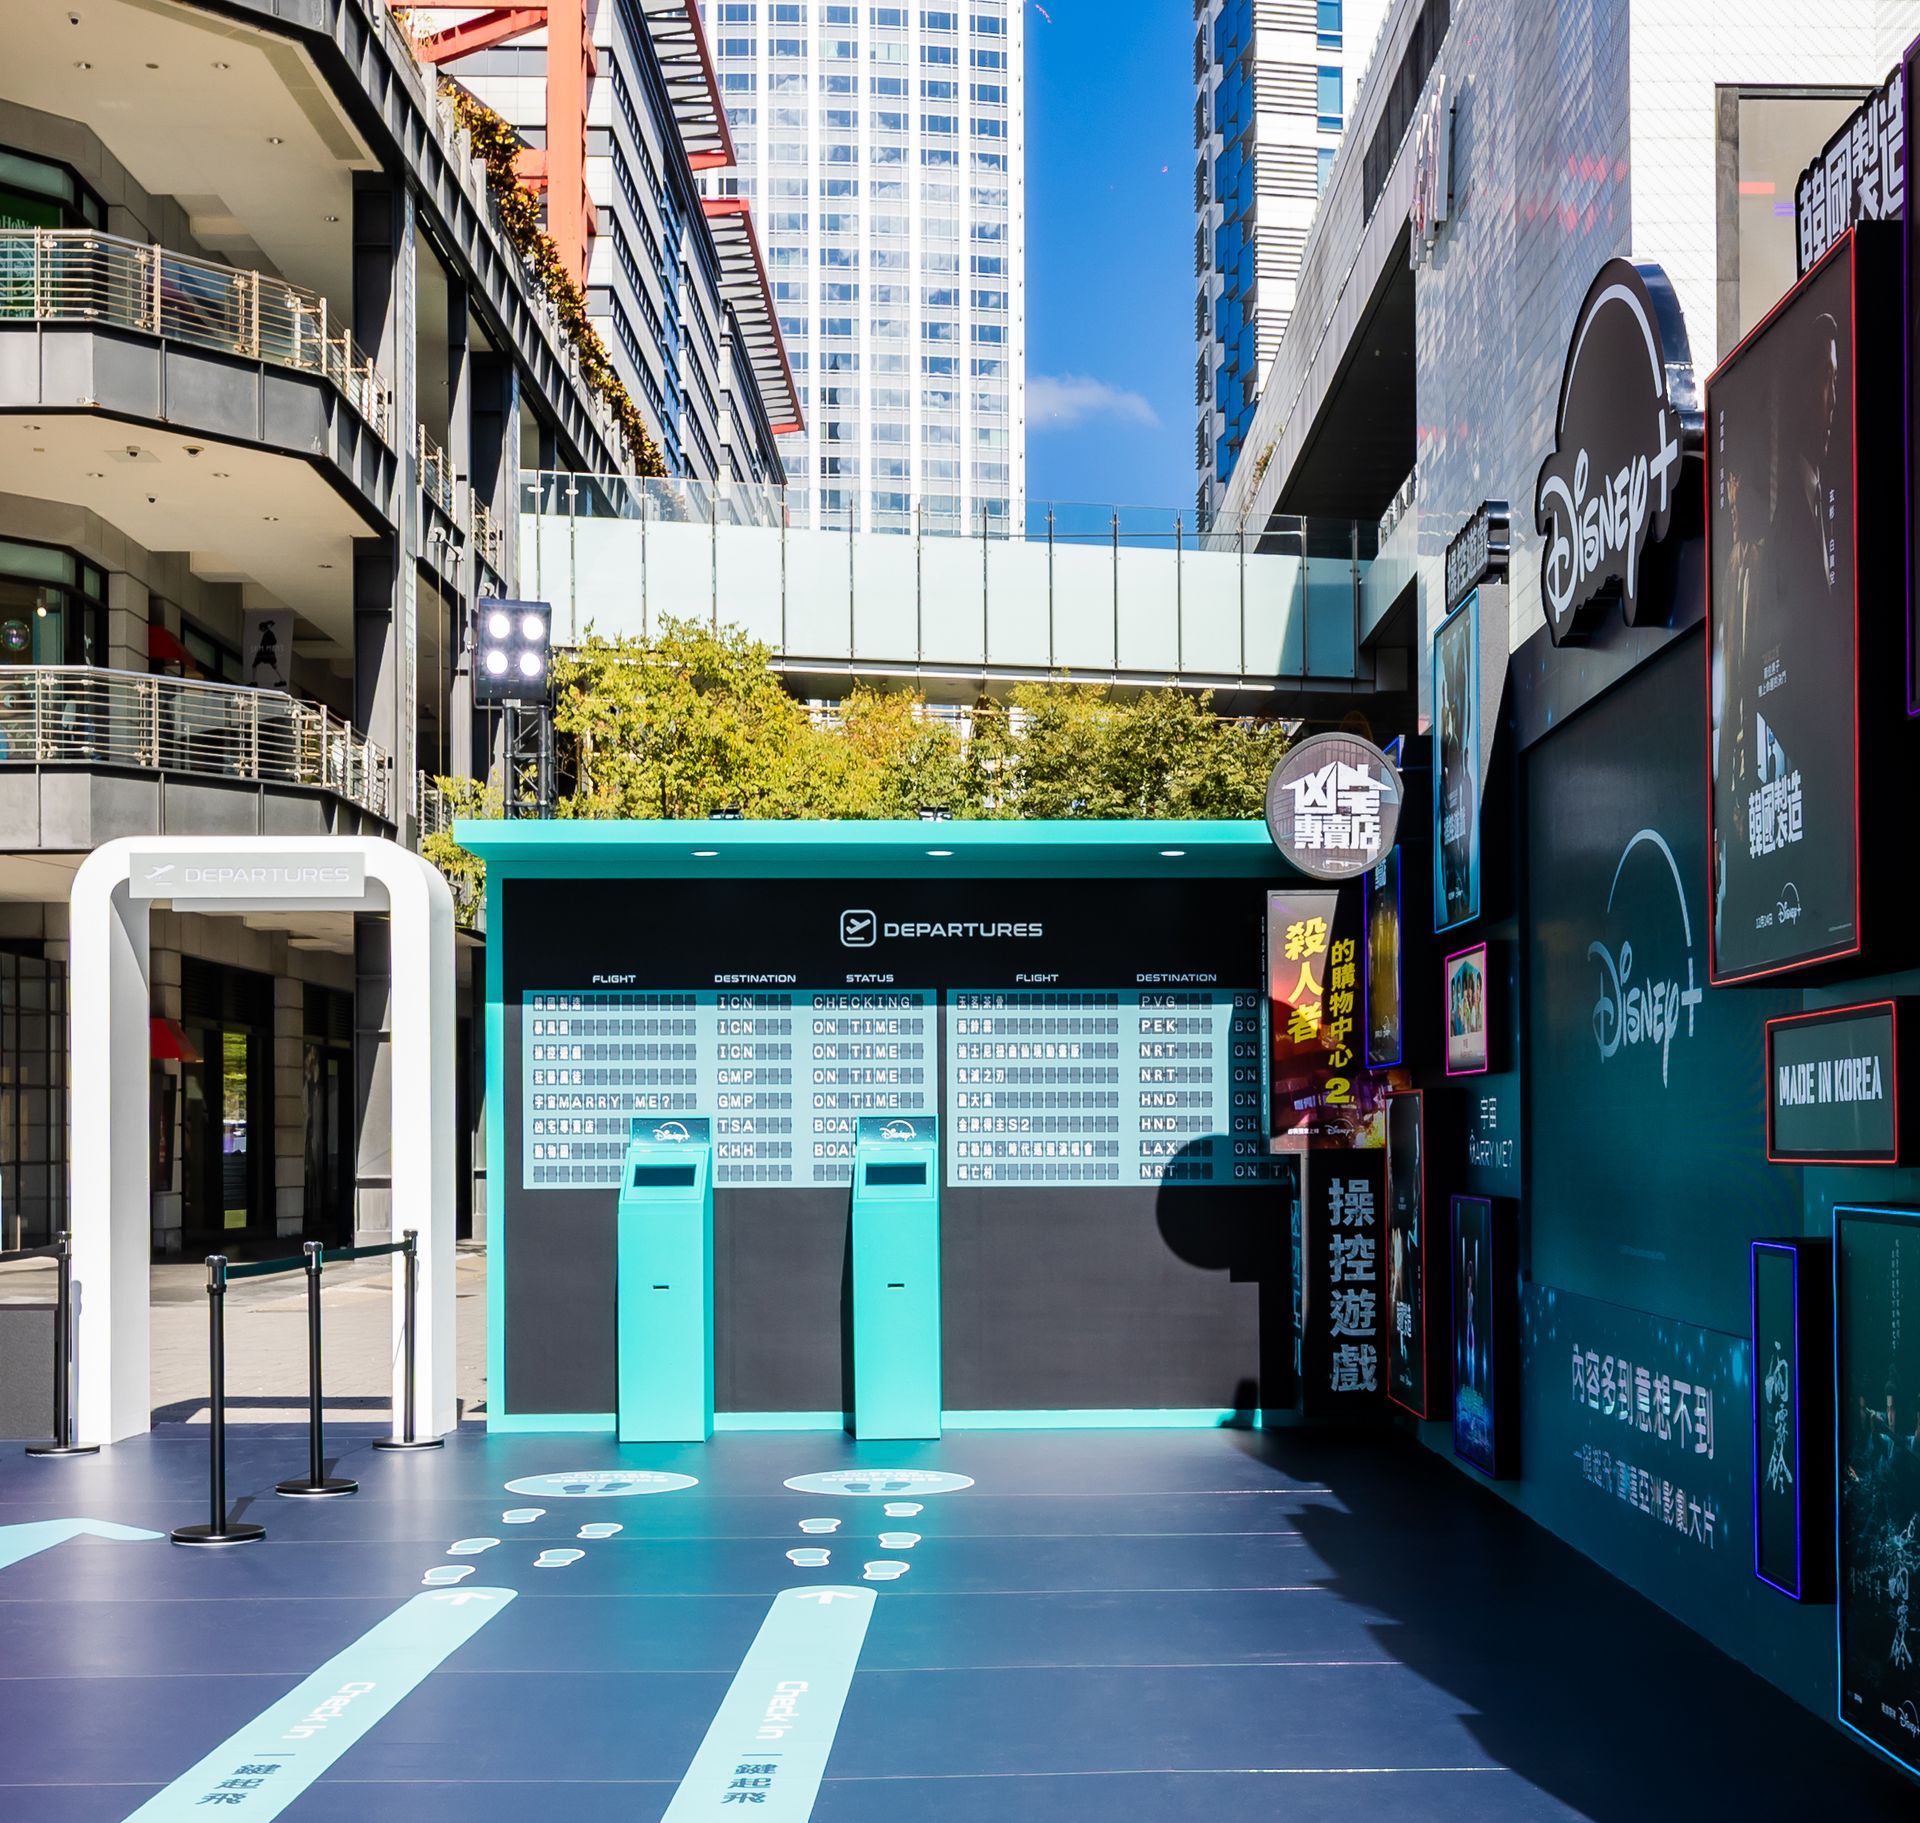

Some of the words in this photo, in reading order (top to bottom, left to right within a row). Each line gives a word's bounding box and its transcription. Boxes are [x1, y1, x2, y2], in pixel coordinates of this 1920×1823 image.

[1748, 769, 1804, 859] 韓國製造
[1294, 815, 1382, 850] 專賣店
[184, 866, 350, 884] DEPARTURES
[884, 922, 1043, 938] DEPARTURES
[592, 974, 637, 984] FLIGHT
[714, 974, 797, 983] DESTINATION
[846, 974, 895, 983] STATUS
[1015, 973, 1059, 983] FLIGHT
[1136, 974, 1217, 983] DESTINATION
[1284, 916, 1328, 1044] 殺人者
[719, 997, 753, 1009] ICN
[814, 996, 911, 1009] CHECKING
[1142, 996, 1175, 1008] PVG
[1588, 941, 1703, 1089] Disney+
[719, 1021, 753, 1033] ICN
[814, 1021, 836, 1033] ON
[852, 1021, 898, 1033] TIME
[1142, 1020, 1176, 1032] PEK
[719, 1046, 753, 1058] ICN
[814, 1046, 836, 1057] ON
[852, 1046, 898, 1057] TIME
[1142, 1044, 1175, 1056] NRT
[1235, 1045, 1256, 1056] ON
[719, 1071, 753, 1083] GMP
[814, 1070, 836, 1082] ON
[852, 1070, 898, 1082] TIME
[958, 1069, 1004, 1083] 鬼滅之刃
[1142, 1069, 1175, 1081] NRT
[1235, 1069, 1256, 1080] ON
[1779, 1062, 1815, 1106] MADE
[1818, 1060, 1832, 1103] IN
[1834, 1056, 1883, 1102] KOREA
[635, 1096, 670, 1108] ME?
[719, 1095, 753, 1107] GMP
[814, 1095, 836, 1107] ON
[852, 1095, 898, 1107] TIME
[1142, 1093, 1175, 1105] HND
[1235, 1094, 1256, 1105] ON
[719, 1120, 753, 1132] TSA
[1142, 1118, 1175, 1130] HND
[719, 1144, 753, 1157] KHH
[1142, 1142, 1176, 1155] LAX
[1235, 1143, 1256, 1154] ON
[1142, 1165, 1175, 1177] NRT
[1235, 1165, 1257, 1177] ON
[1328, 1177, 1379, 1393] 操控遊戲
[1571, 1343, 1714, 1460] 內容多到意想不到
[302, 1681, 376, 1722] Check
[763, 1680, 809, 1722] Check
[280, 1725, 327, 1740] In
[755, 1726, 793, 1740] In
